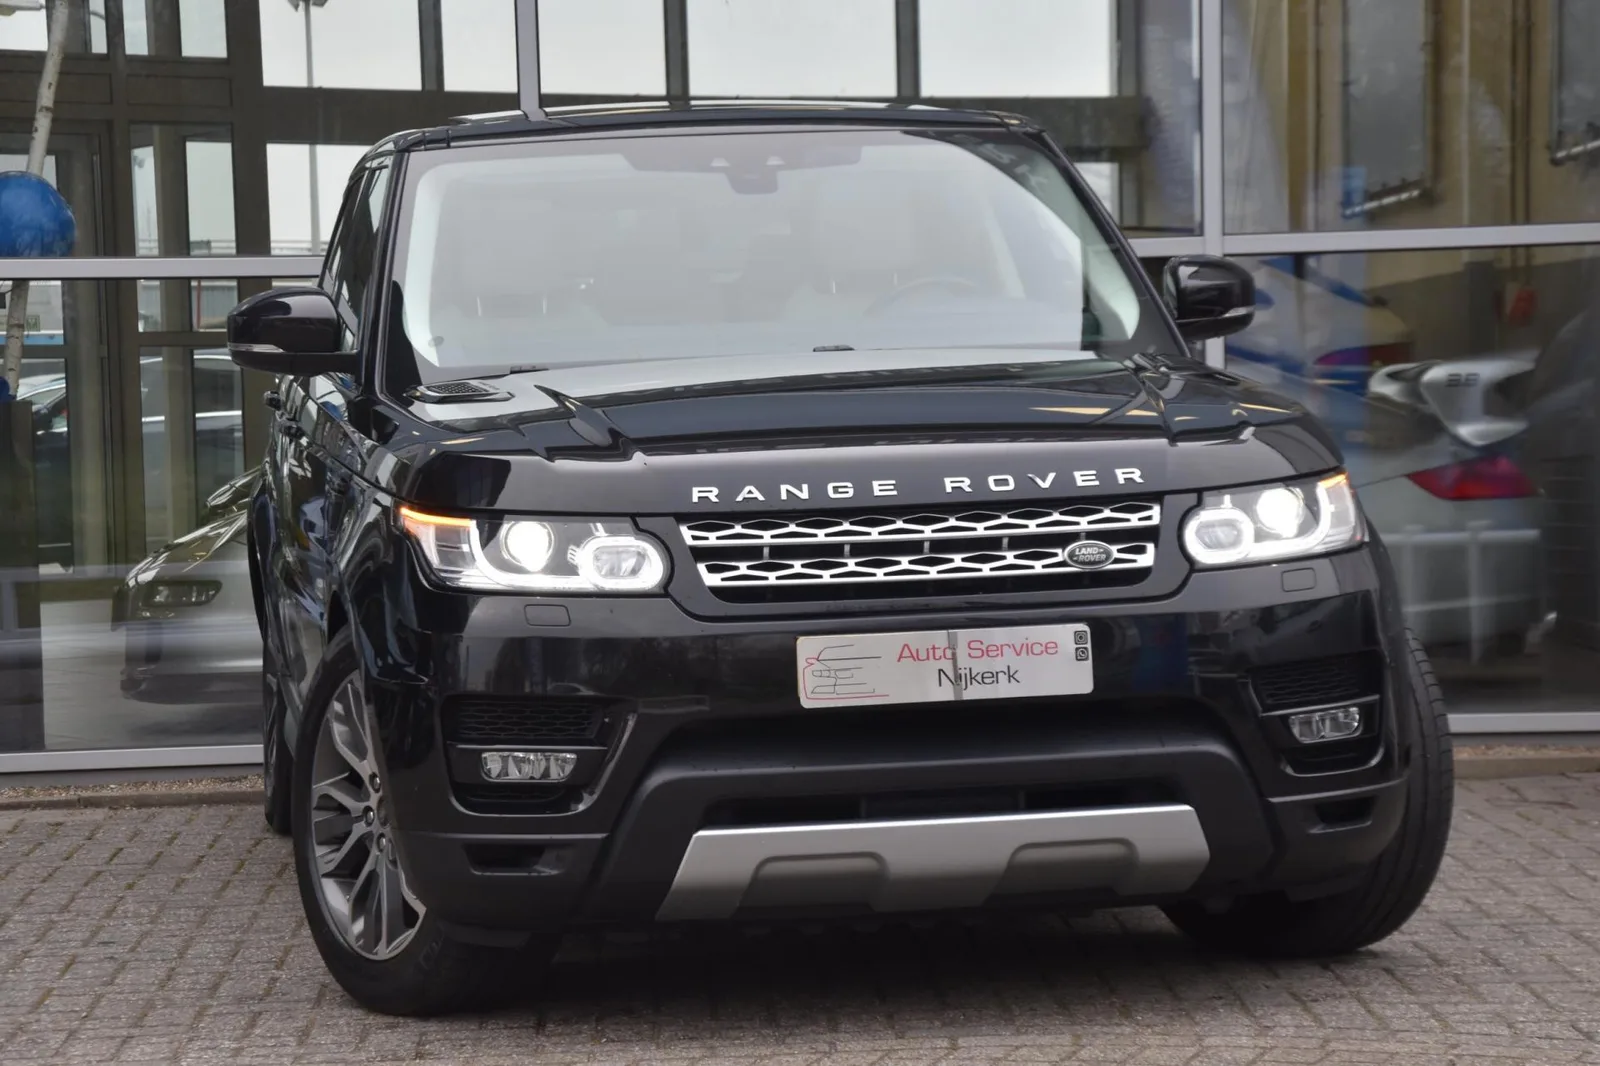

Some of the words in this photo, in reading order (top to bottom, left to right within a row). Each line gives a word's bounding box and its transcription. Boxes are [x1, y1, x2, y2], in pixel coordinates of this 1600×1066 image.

[692, 480, 898, 503] RANGE
[943, 467, 1145, 494] ROVER
[1075, 547, 1099, 555] LAND
[1078, 554, 1107, 562] ROVER
[897, 643, 956, 662] Auto
[967, 638, 1058, 659] Service
[938, 665, 1020, 690] Nijkerk
